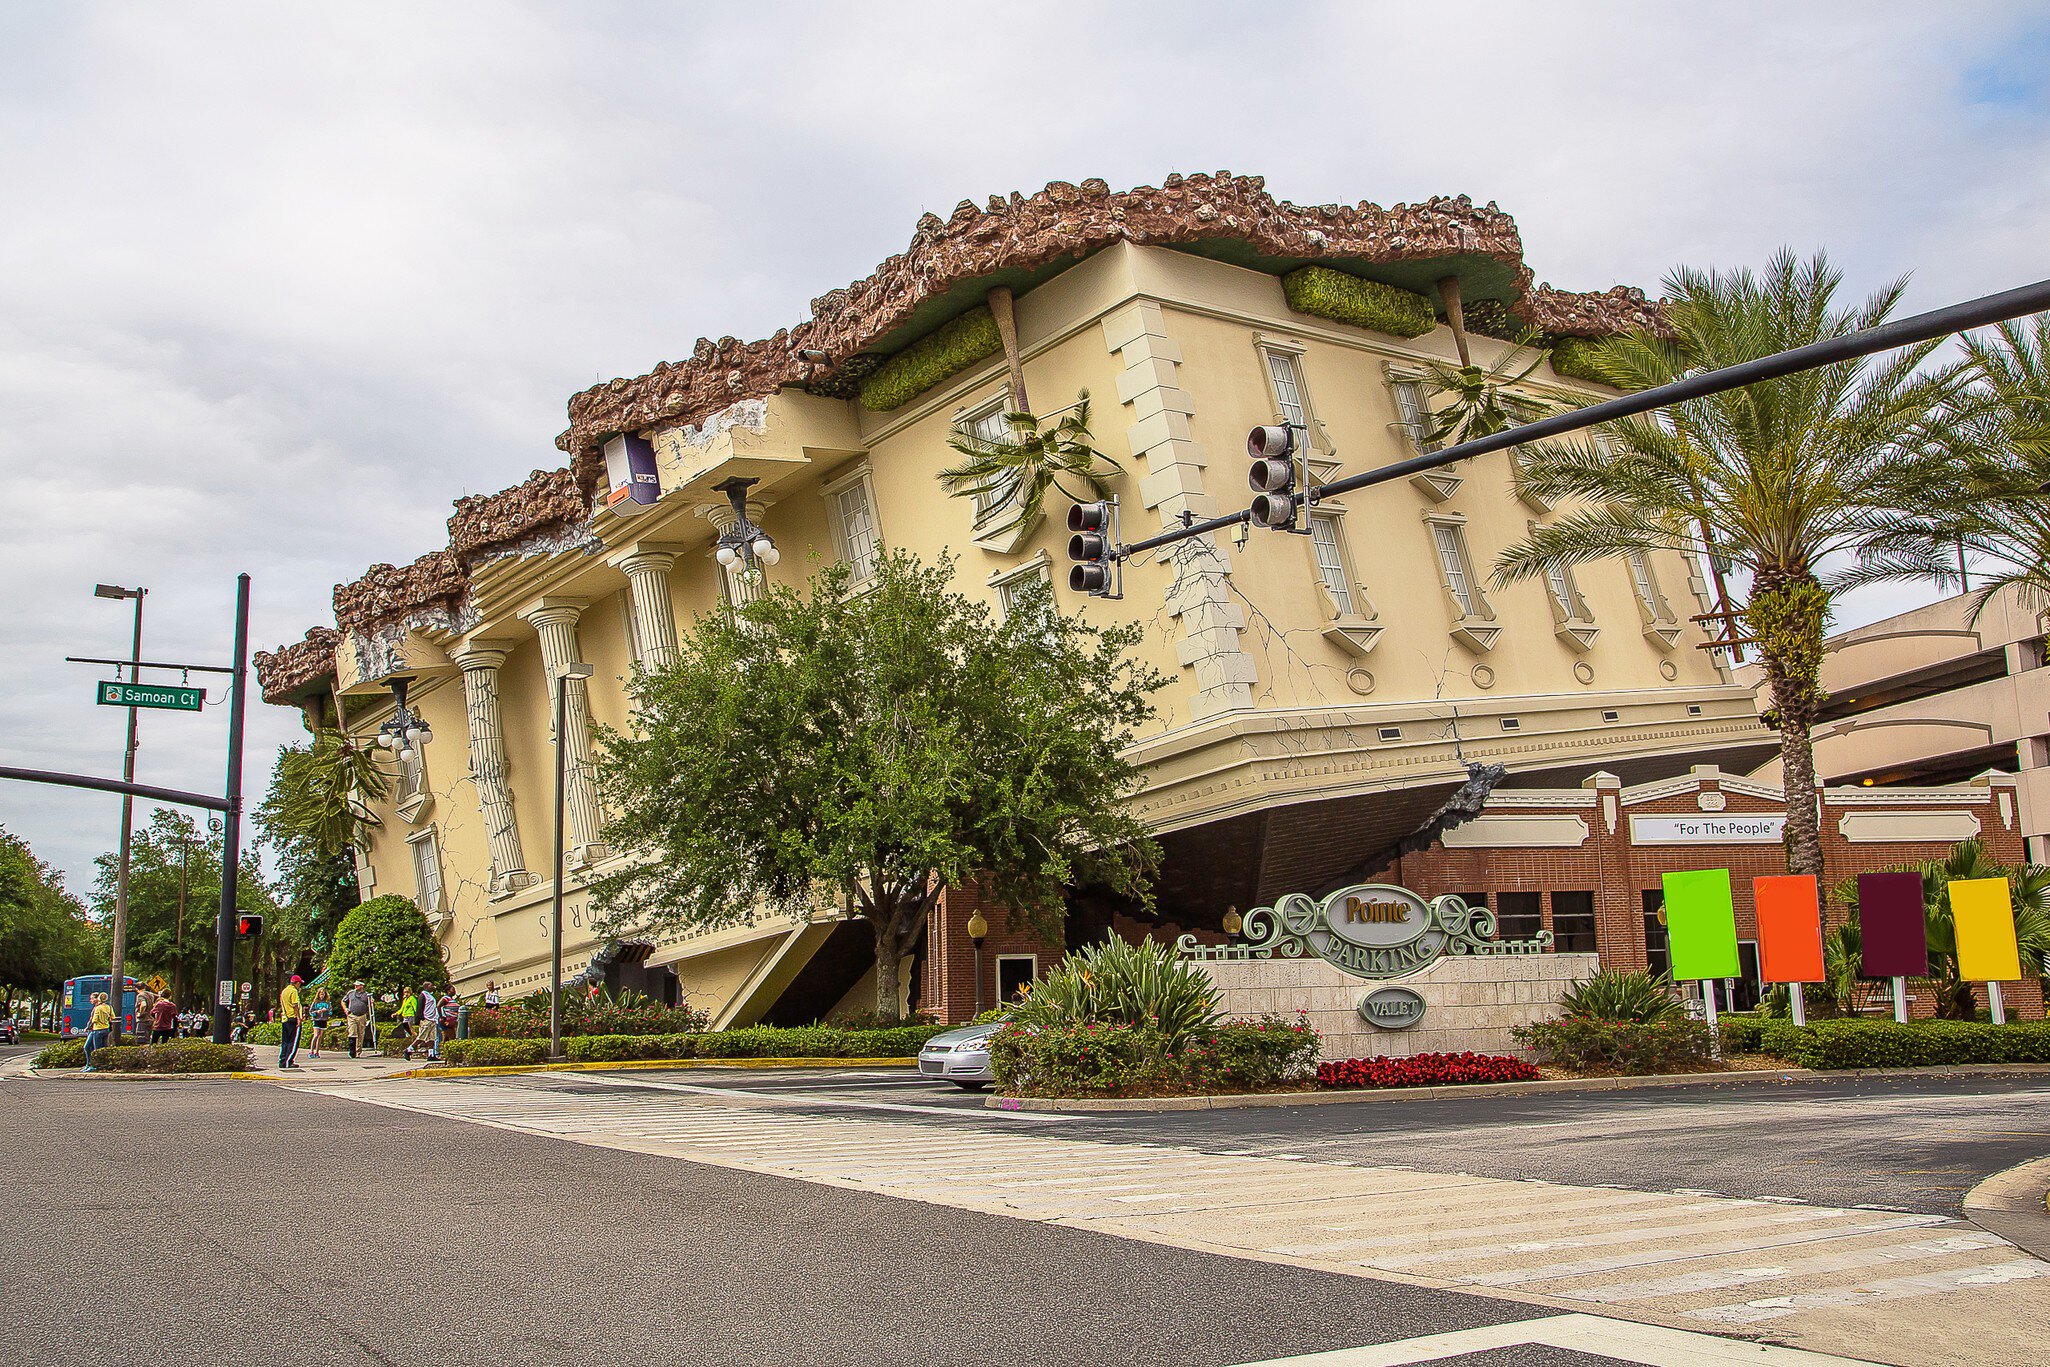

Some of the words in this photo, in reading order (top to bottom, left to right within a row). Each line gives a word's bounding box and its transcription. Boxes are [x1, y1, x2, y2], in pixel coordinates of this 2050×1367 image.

[125, 689, 175, 704] Samoan
[181, 693, 195, 706] Ct
[1703, 822, 1726, 835] The
[1346, 896, 1412, 924] Pointe
[1322, 934, 1434, 972] PARKING
[1367, 999, 1420, 1017] VALET
